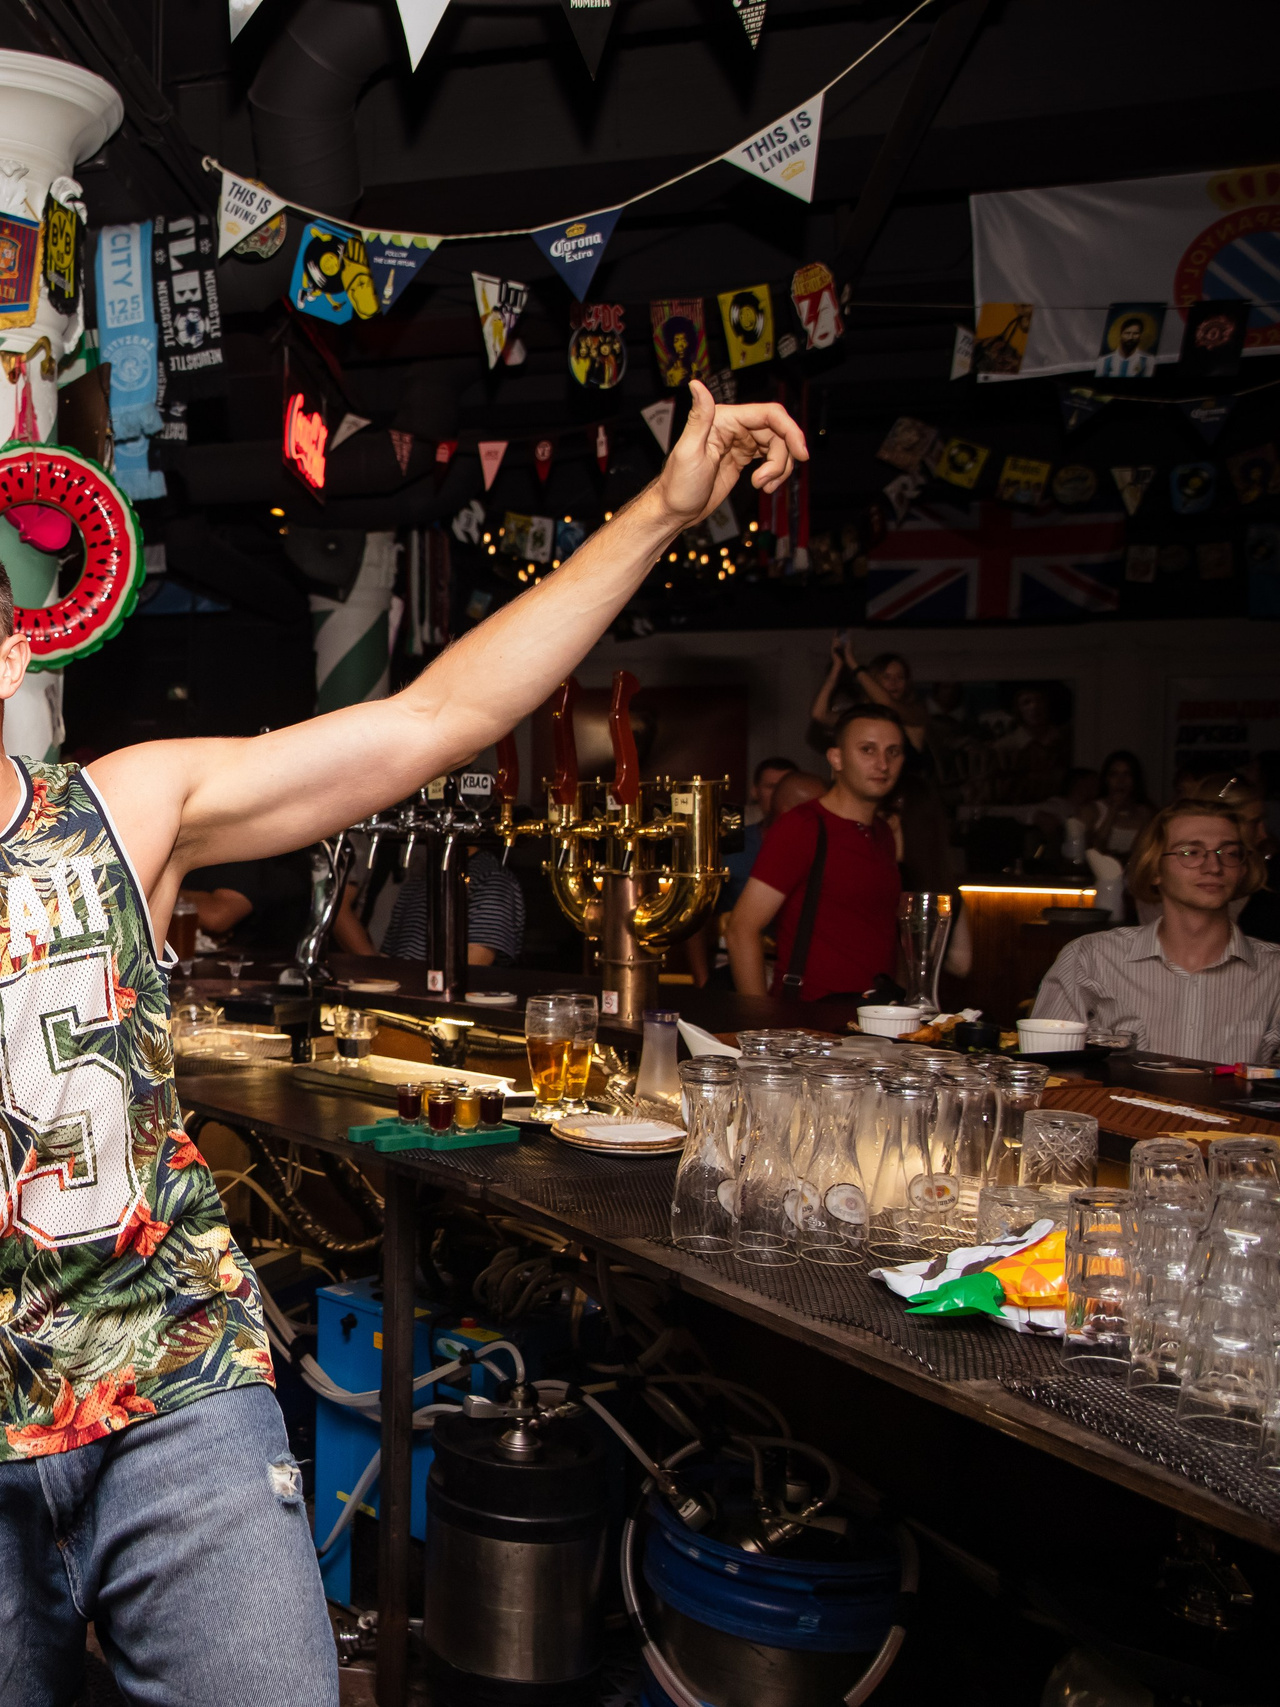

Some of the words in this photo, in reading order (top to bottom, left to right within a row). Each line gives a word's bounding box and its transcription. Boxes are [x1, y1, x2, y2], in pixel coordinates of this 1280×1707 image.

[741, 126, 788, 163] THIS
[789, 111, 812, 134] IS
[759, 135, 812, 174] LIVING
[224, 201, 258, 225] LIVING
[228, 182, 256, 207] THIS
[256, 197, 273, 214] IS
[52, 217, 72, 256] BVB
[549, 232, 603, 257] Corona
[110, 232, 133, 288] CITY
[565, 249, 594, 263] Extra
[109, 295, 141, 316] 125
[157, 280, 177, 348] NEWCASTLE
[204, 269, 222, 339] NEWCASTLE
[570, 302, 627, 334] AC/DC
